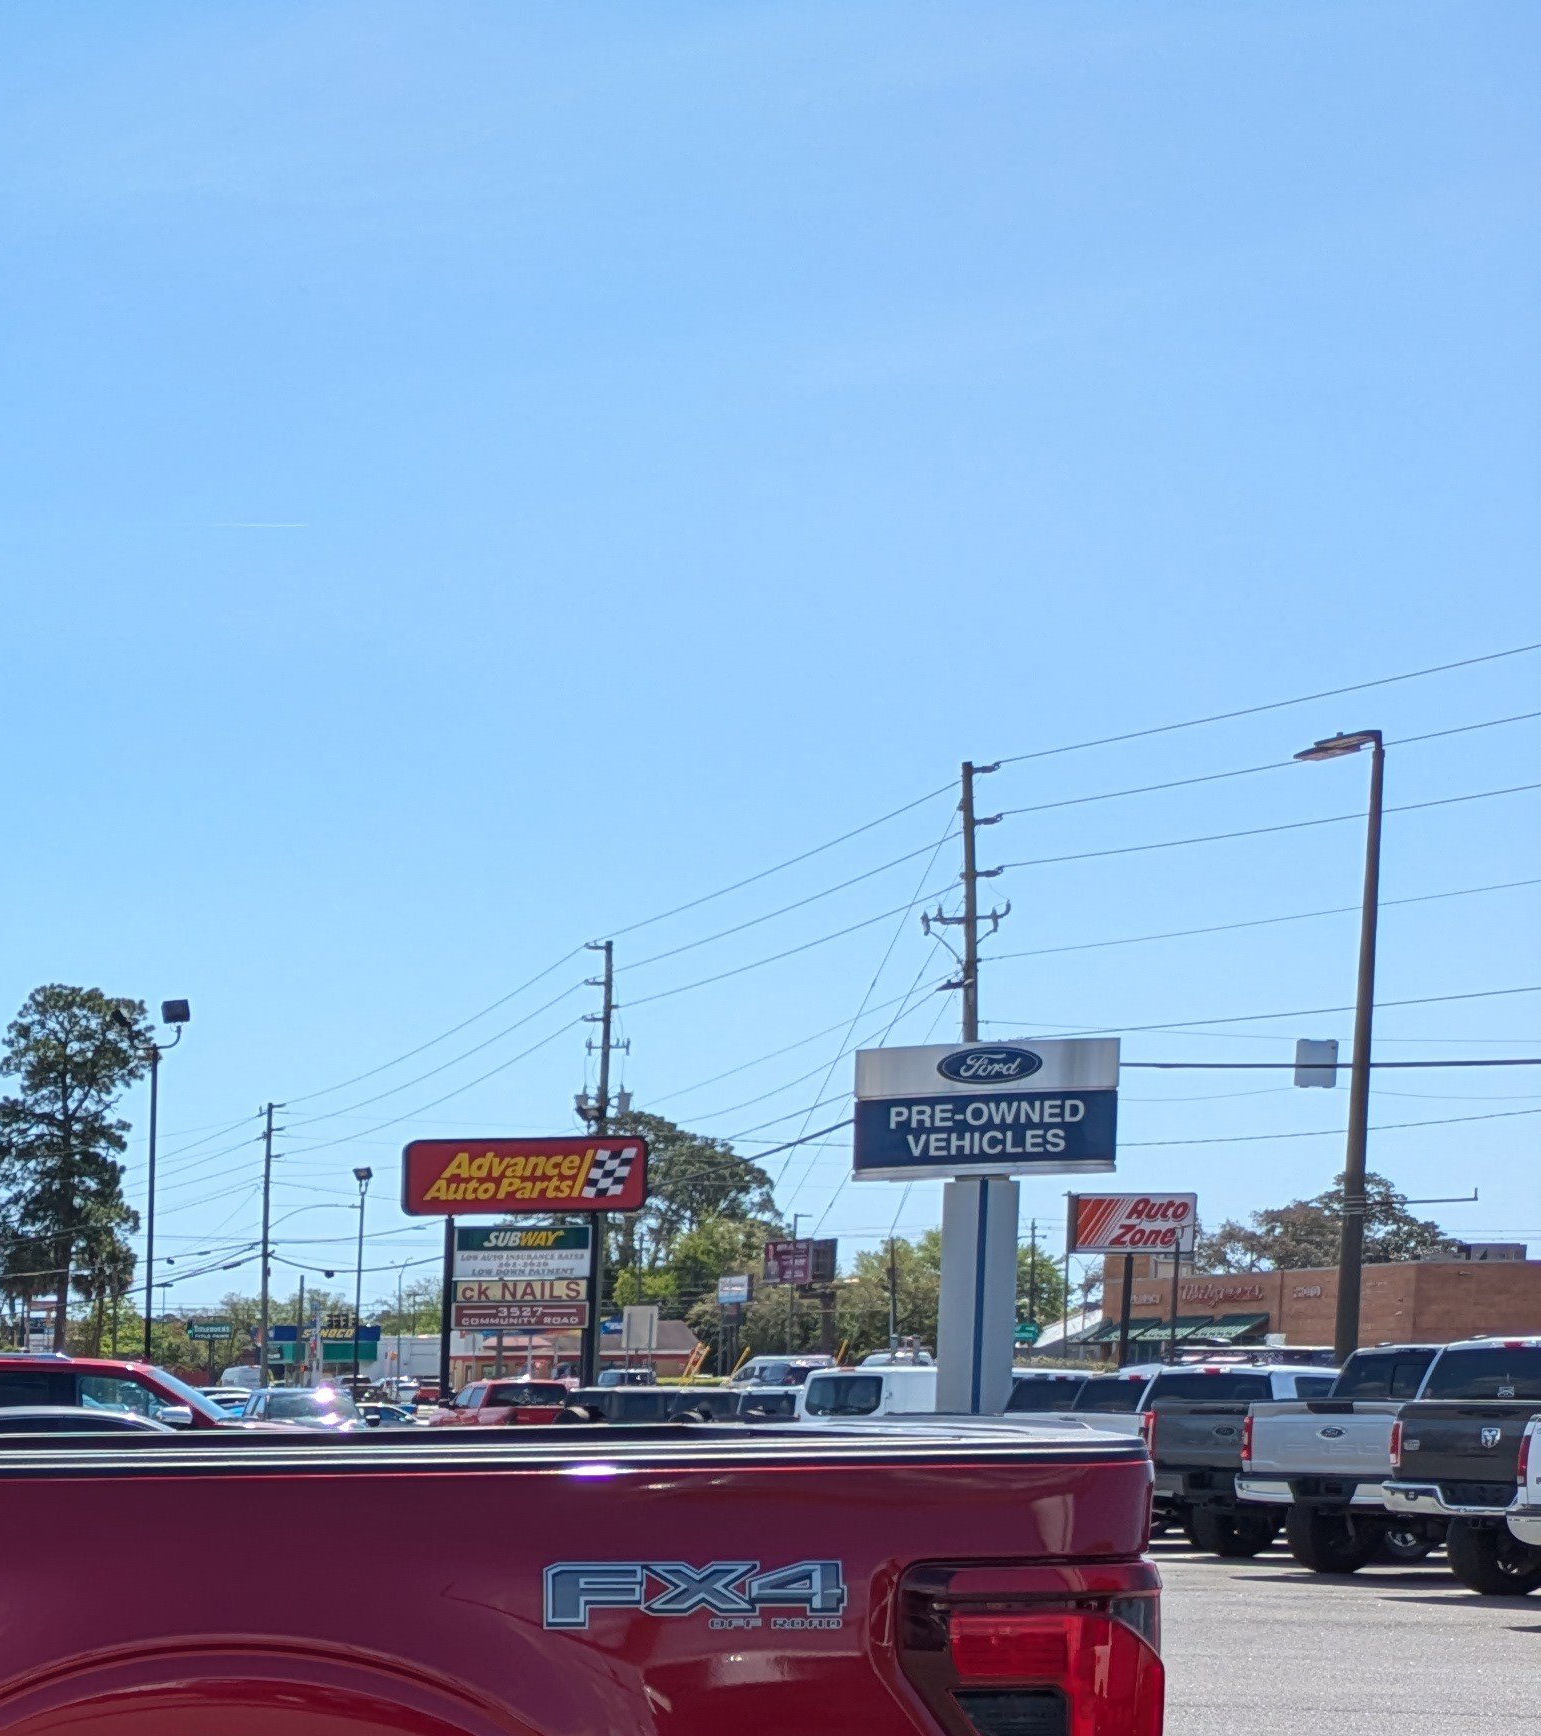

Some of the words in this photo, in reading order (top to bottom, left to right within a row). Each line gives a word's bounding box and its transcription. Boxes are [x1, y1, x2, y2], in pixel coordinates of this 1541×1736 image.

[960, 1053, 1022, 1079] Ford
[889, 1099, 1085, 1129] PRE-OWNED
[907, 1129, 1066, 1157] VEHICLES
[440, 1151, 581, 1179] Advance
[422, 1179, 496, 1201] Auto
[496, 1177, 573, 1199] Parts
[1125, 1198, 1191, 1221] Auto
[482, 1229, 565, 1248] SUBWAY
[1109, 1224, 1178, 1248] Zone
[501, 1280, 581, 1300] NAILS
[461, 1317, 537, 1326] COMMUNITY
[543, 1316, 579, 1325] ROAD
[301, 1328, 355, 1339] SNOCO
[542, 1560, 848, 1630] FX4
[708, 1617, 762, 1630] OFF
[771, 1617, 843, 1630] ROAD
